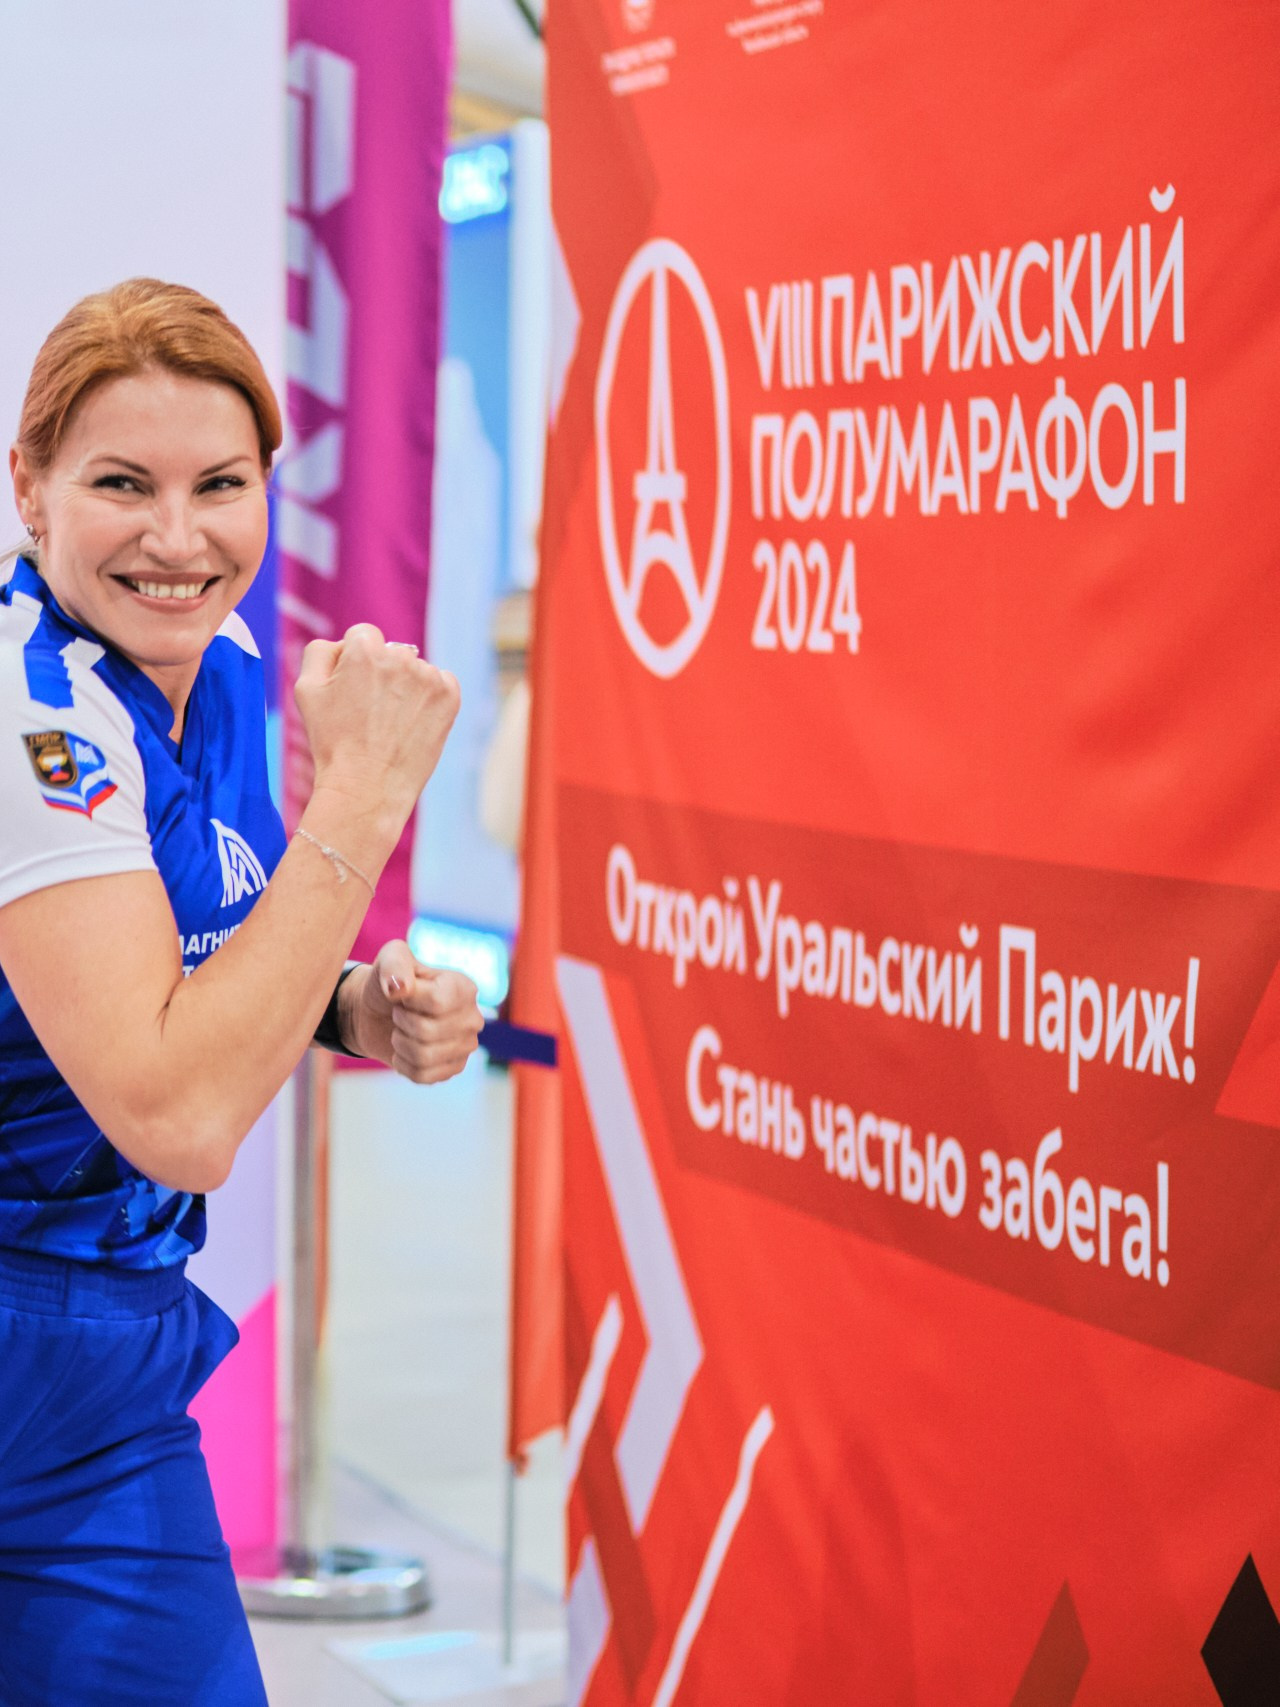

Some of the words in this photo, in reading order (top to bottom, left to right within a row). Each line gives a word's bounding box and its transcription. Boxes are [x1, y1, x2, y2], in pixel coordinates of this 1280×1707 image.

[745, 280, 814, 390] VIII
[821, 184, 1185, 386] ПАРИЖСКИЙ
[751, 377, 1187, 521] ПОЛУМАРАФОН
[751, 539, 862, 654] 2024
[606, 845, 747, 988] Открой
[747, 876, 983, 1034] Уральский
[998, 924, 1201, 1094] Париж!
[686, 1026, 806, 1161] Стань
[811, 1095, 968, 1218] частью
[978, 1127, 1171, 1288] забега!
